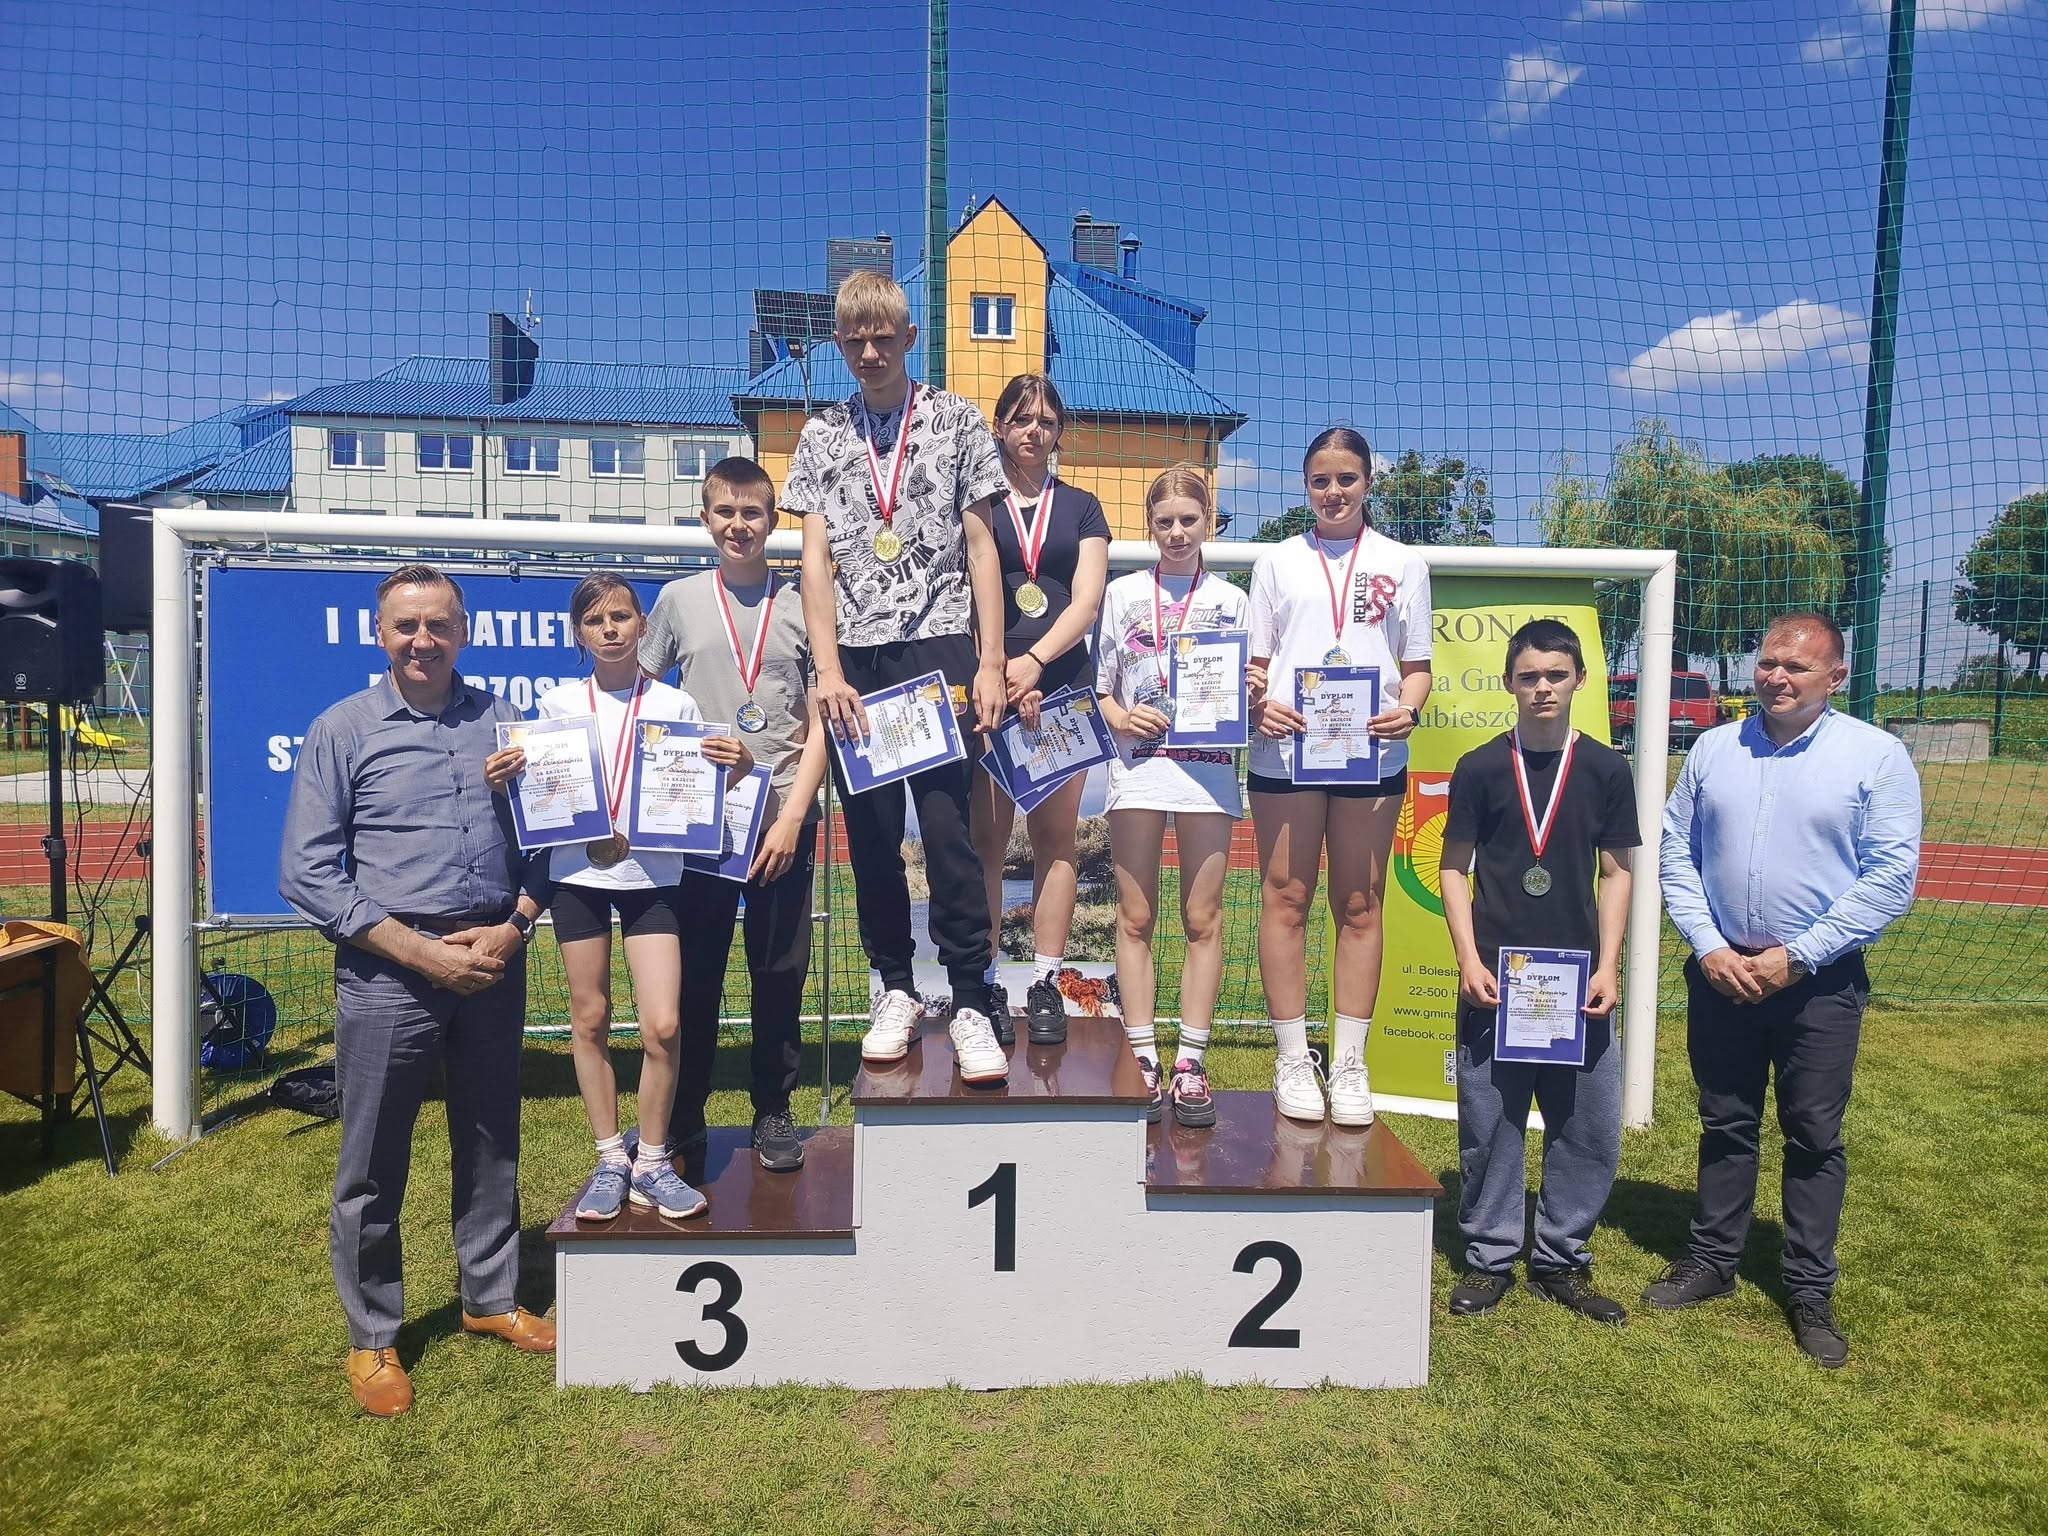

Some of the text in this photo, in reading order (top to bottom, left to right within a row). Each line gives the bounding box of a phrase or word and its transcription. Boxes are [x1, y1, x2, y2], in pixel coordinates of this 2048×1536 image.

[1353, 572, 1368, 623] RECKLESS
[916, 706, 931, 740] DYPLOM
[1068, 716, 1086, 746] DYPLOM
[663, 749, 698, 757] DYPLOM
[1402, 964, 1415, 974] ul.
[1408, 985, 1448, 998] 22-500
[969, 1163, 1016, 1271] 1
[1228, 1241, 1302, 1348] 2
[675, 1262, 748, 1371] 3
